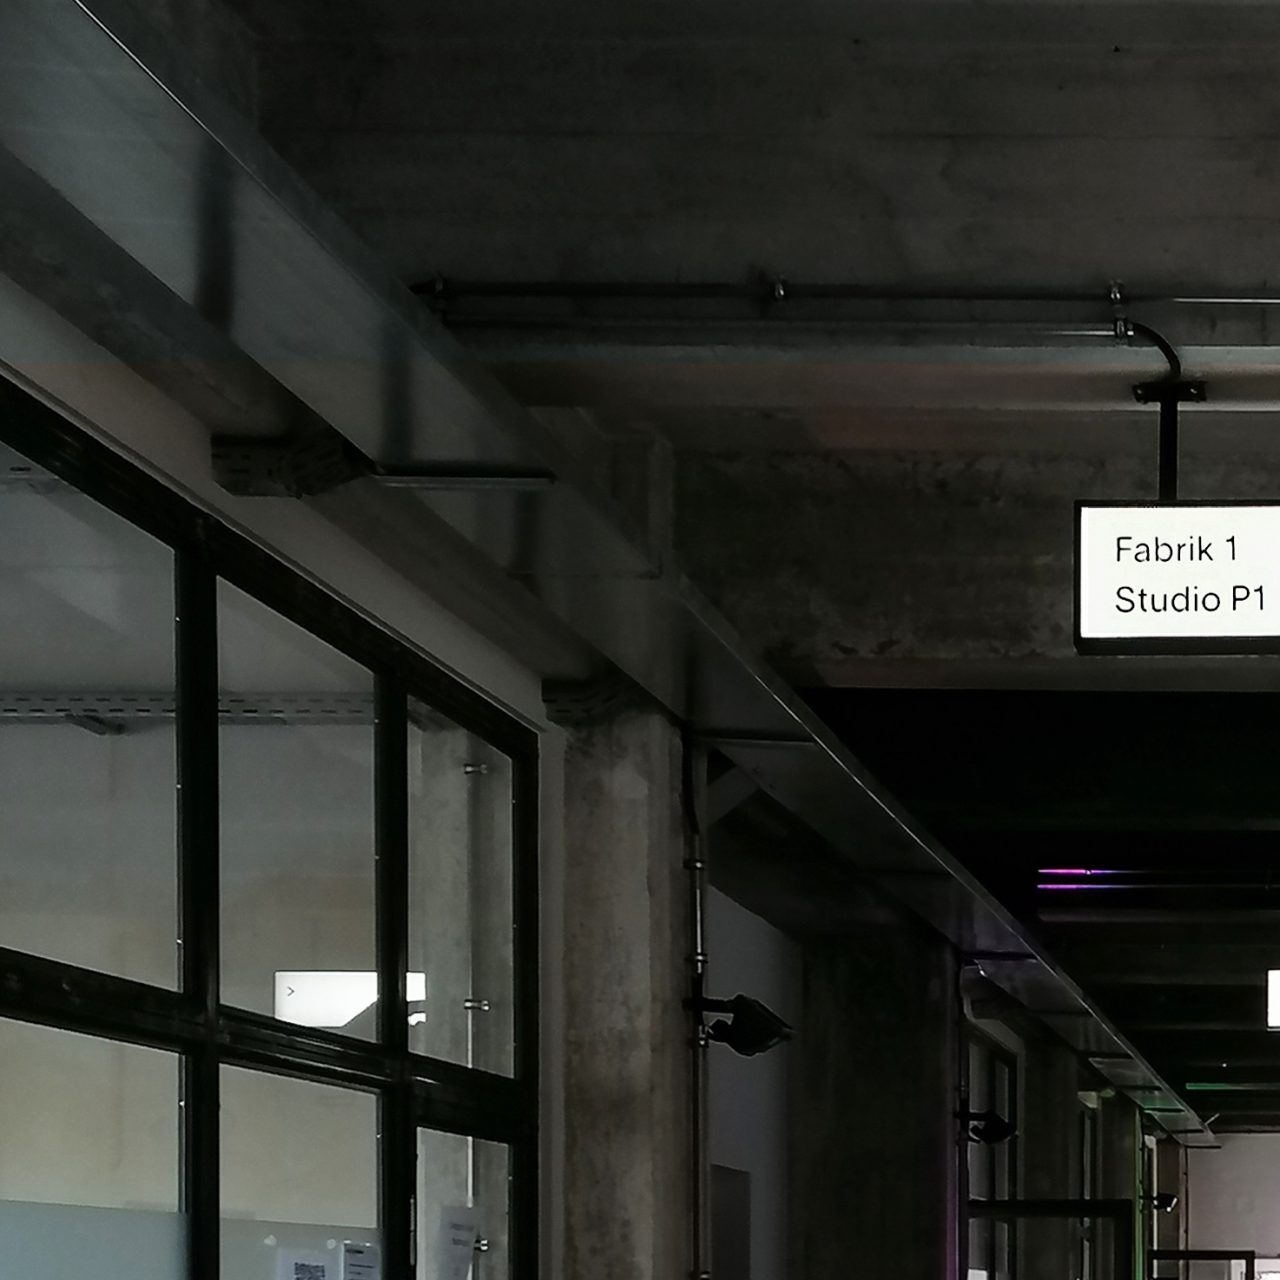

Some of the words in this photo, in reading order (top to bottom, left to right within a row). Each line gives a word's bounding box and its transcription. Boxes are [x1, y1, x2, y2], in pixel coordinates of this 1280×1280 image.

[1116, 535, 1214, 563] Fabrik
[1225, 535, 1237, 561] 1
[1115, 585, 1221, 614] Studio
[1232, 585, 1265, 612] P1
